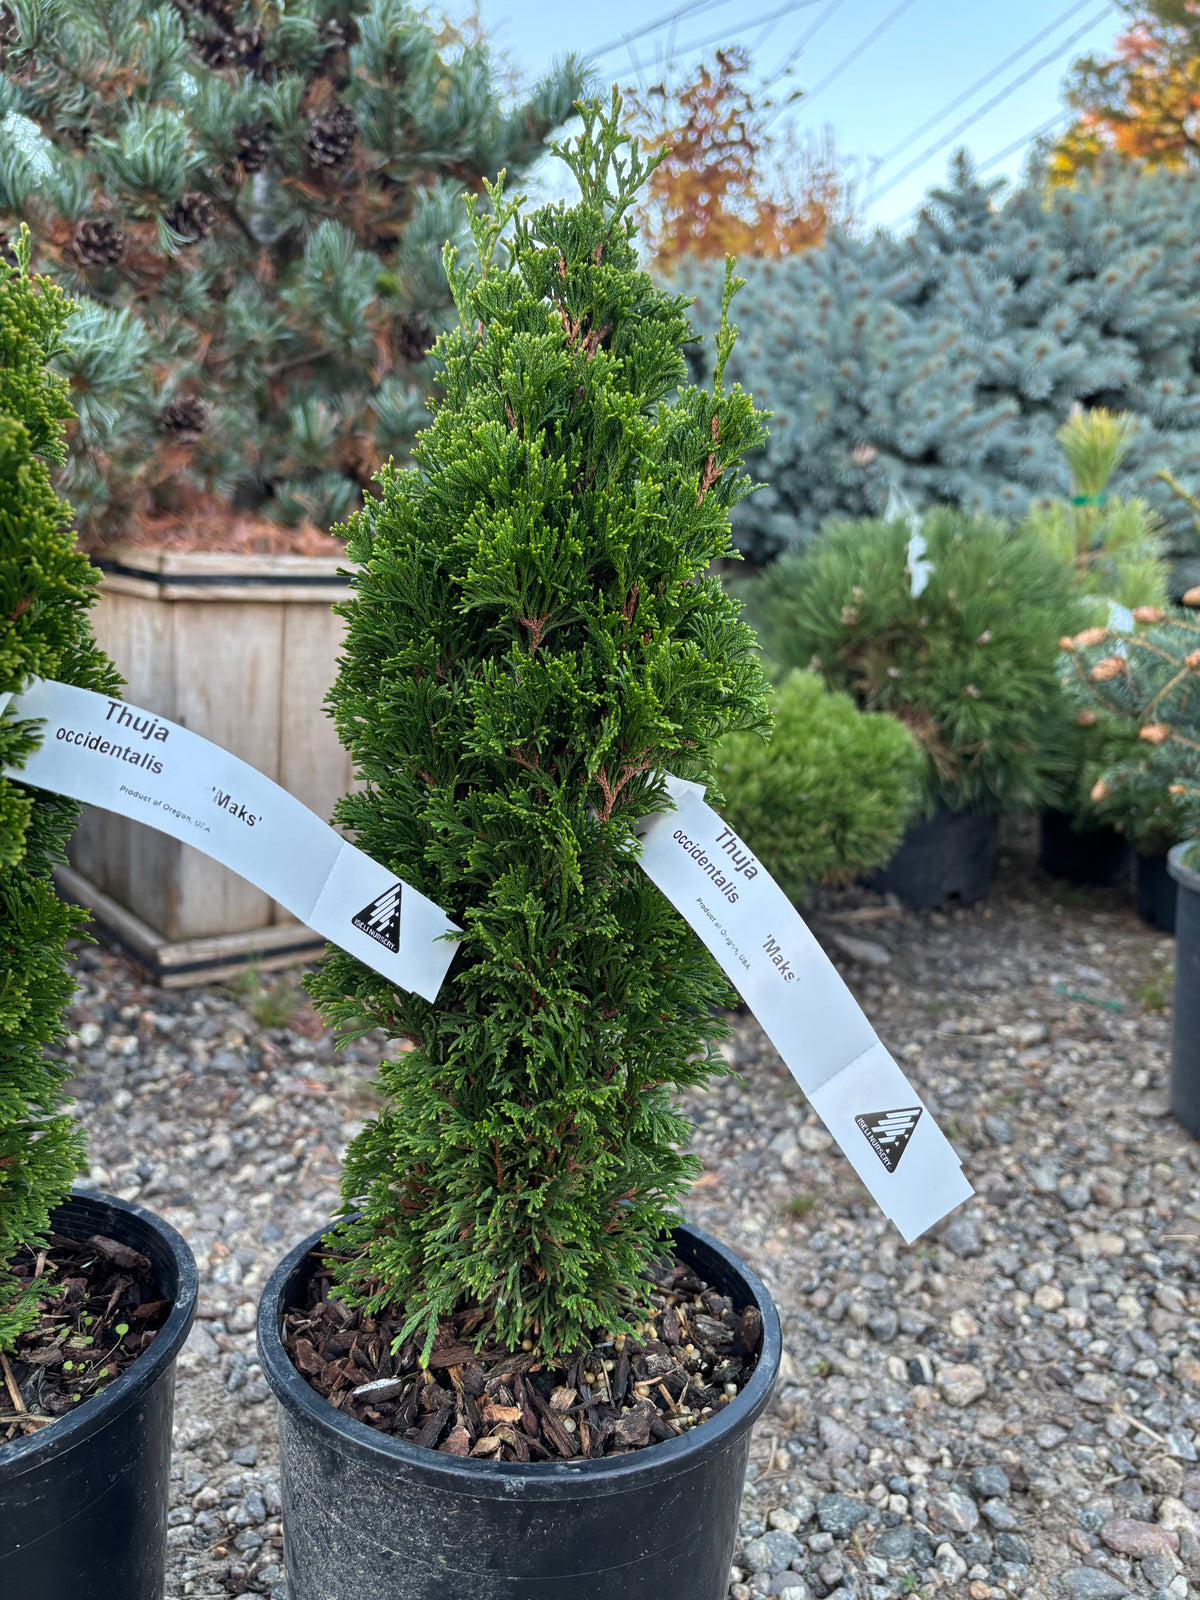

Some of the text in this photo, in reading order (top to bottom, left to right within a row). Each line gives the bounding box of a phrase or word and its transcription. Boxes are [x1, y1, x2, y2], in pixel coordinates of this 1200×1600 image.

[106, 700, 170, 743] Thuja
[55, 727, 164, 775] occidentalis
[119, 785, 152, 803] Product
[212, 786, 262, 827] 'Maks'
[672, 829, 740, 904] occidentalis
[715, 826, 759, 881] Thuja
[354, 918, 395, 950] ISELI NURSERY
[696, 897, 717, 922] Product
[739, 954, 751, 970] USA
[857, 1117, 892, 1167] ISELI NURSERY
